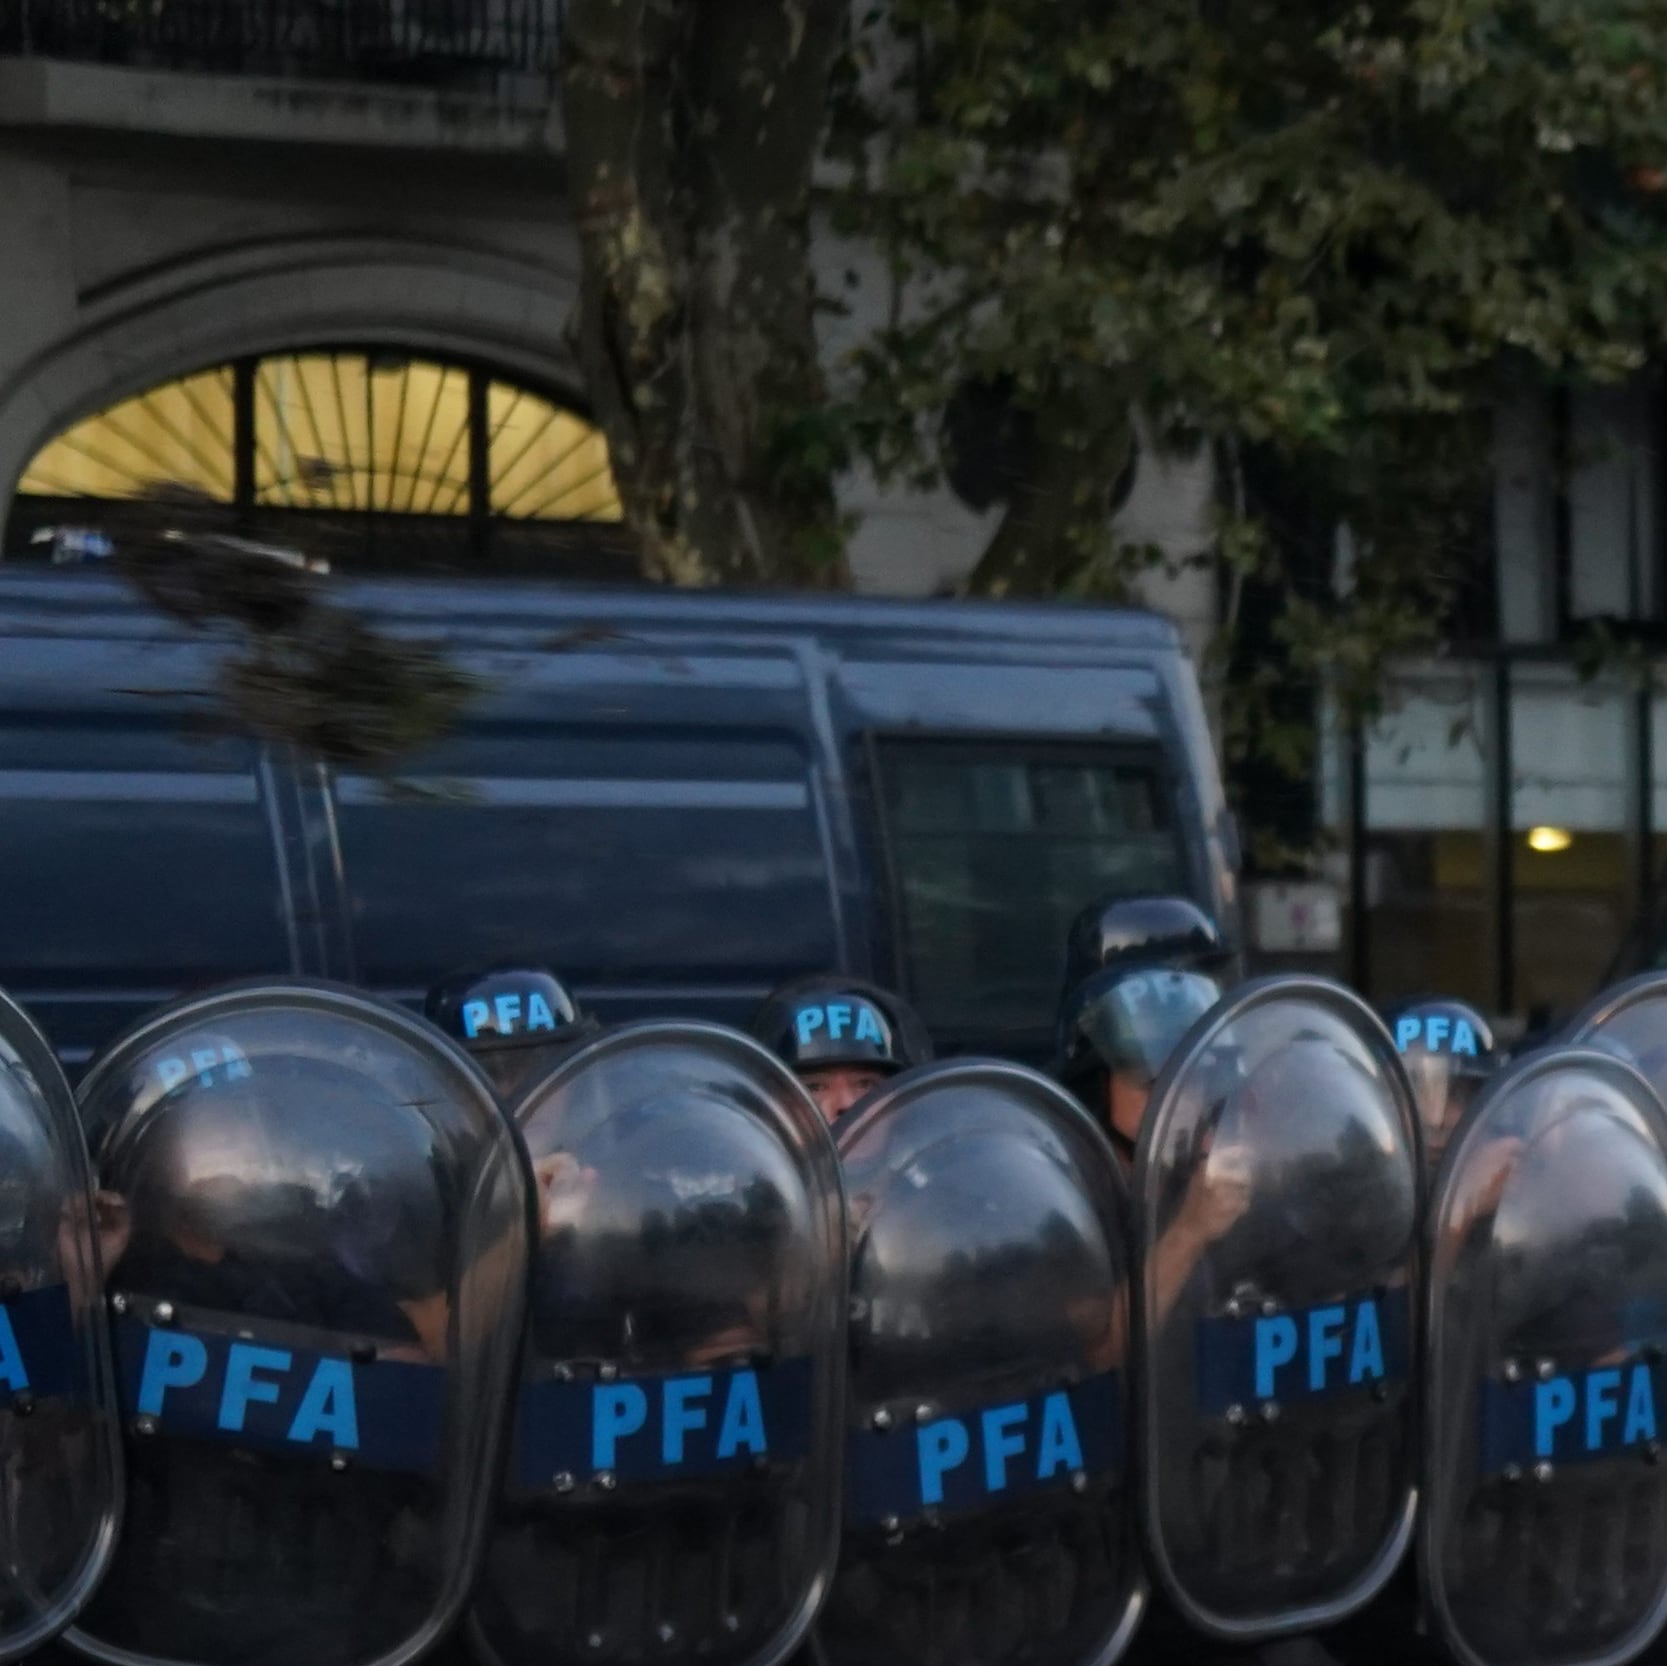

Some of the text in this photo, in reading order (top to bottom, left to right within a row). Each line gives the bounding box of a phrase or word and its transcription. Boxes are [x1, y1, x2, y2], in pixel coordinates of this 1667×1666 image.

[462, 993, 556, 1039] PFA
[797, 1004, 882, 1045] PFA
[1396, 1016, 1479, 1056] PFA
[138, 1327, 359, 1450] PFA
[1256, 1299, 1382, 1399] PFA
[592, 1369, 767, 1470] PFA
[916, 1389, 1083, 1505] PFA
[1535, 1363, 1657, 1458] PFA
